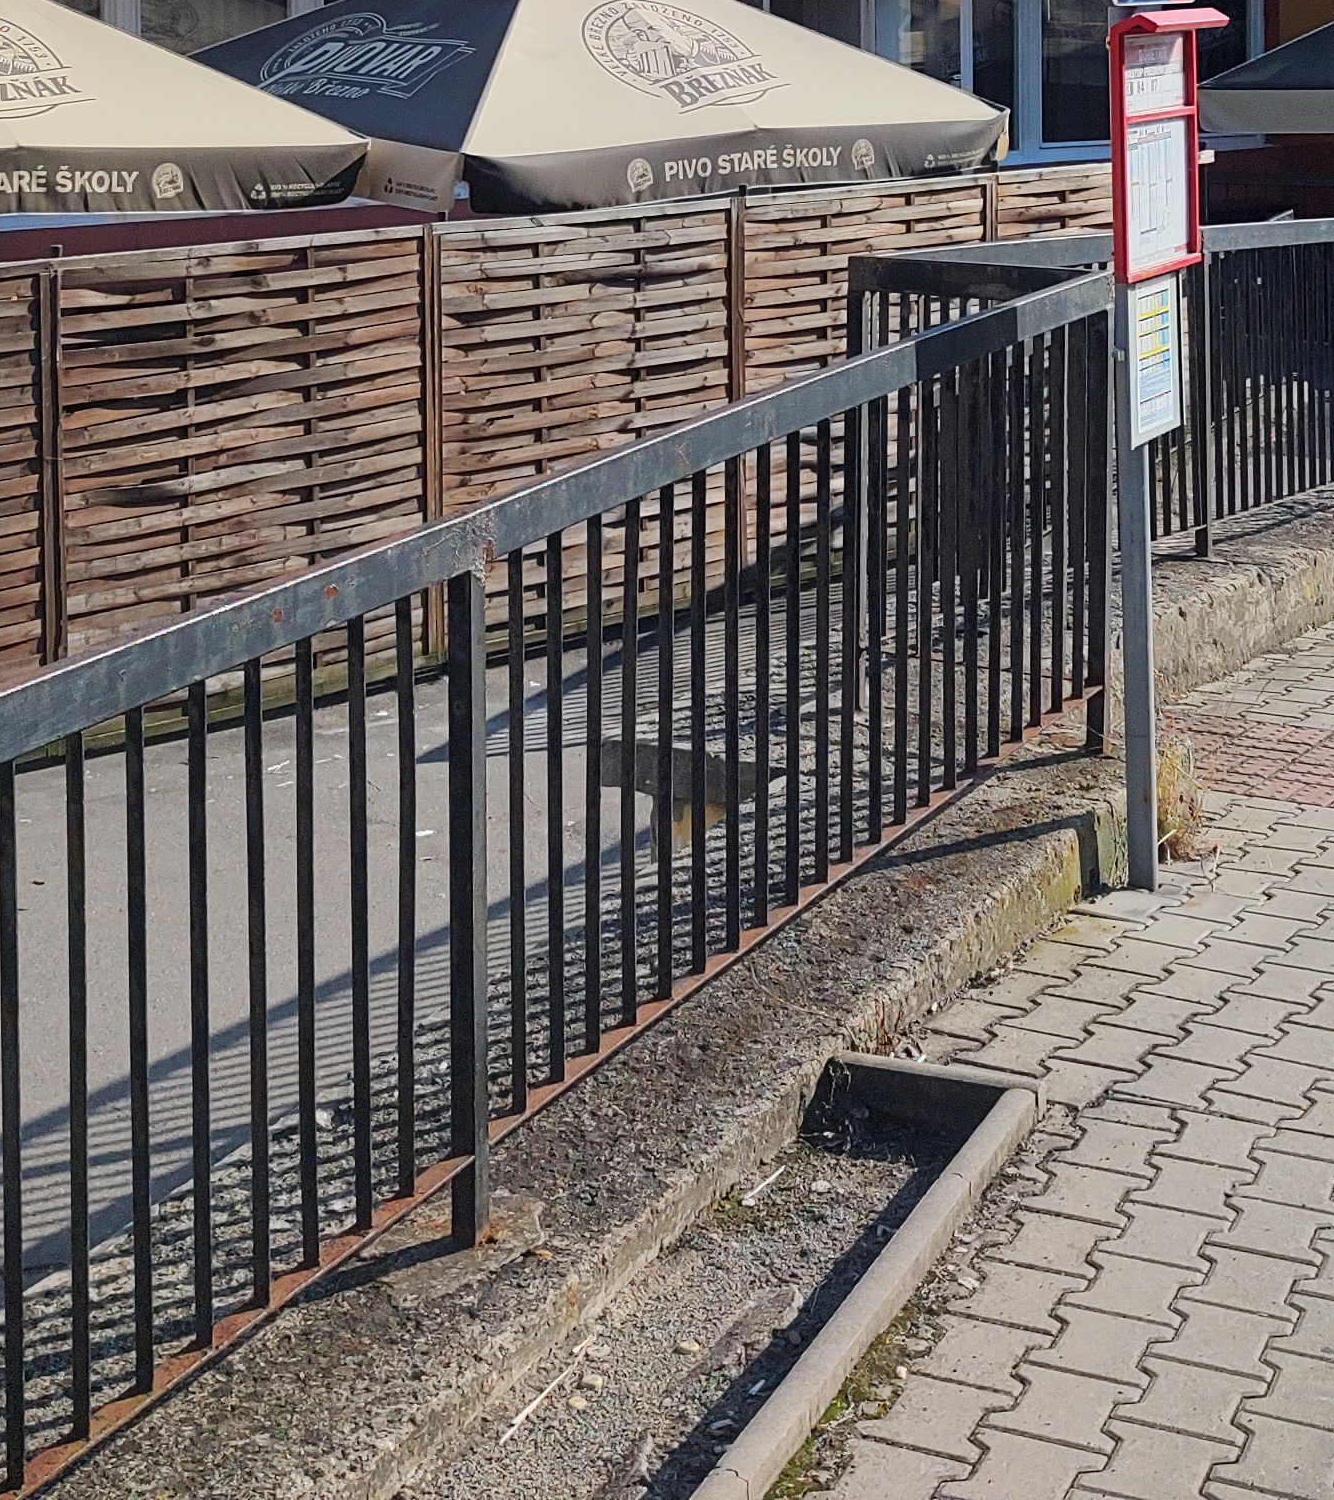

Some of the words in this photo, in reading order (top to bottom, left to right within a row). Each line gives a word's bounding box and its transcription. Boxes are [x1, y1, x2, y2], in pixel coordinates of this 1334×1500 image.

[589, 6, 620, 41] BŘEZNO
[623, 2, 703, 27] ZALOŽENO
[711, 27, 740, 49] 1753
[17, 35, 48, 60] 1753
[303, 78, 371, 99] Březno
[659, 62, 779, 109] BŘEZŇÁK
[55, 165, 139, 193] ŠKOLY
[664, 157, 712, 182] PIVO
[717, 145, 779, 175] STARÉ
[781, 144, 843, 168] ŠKOLY
